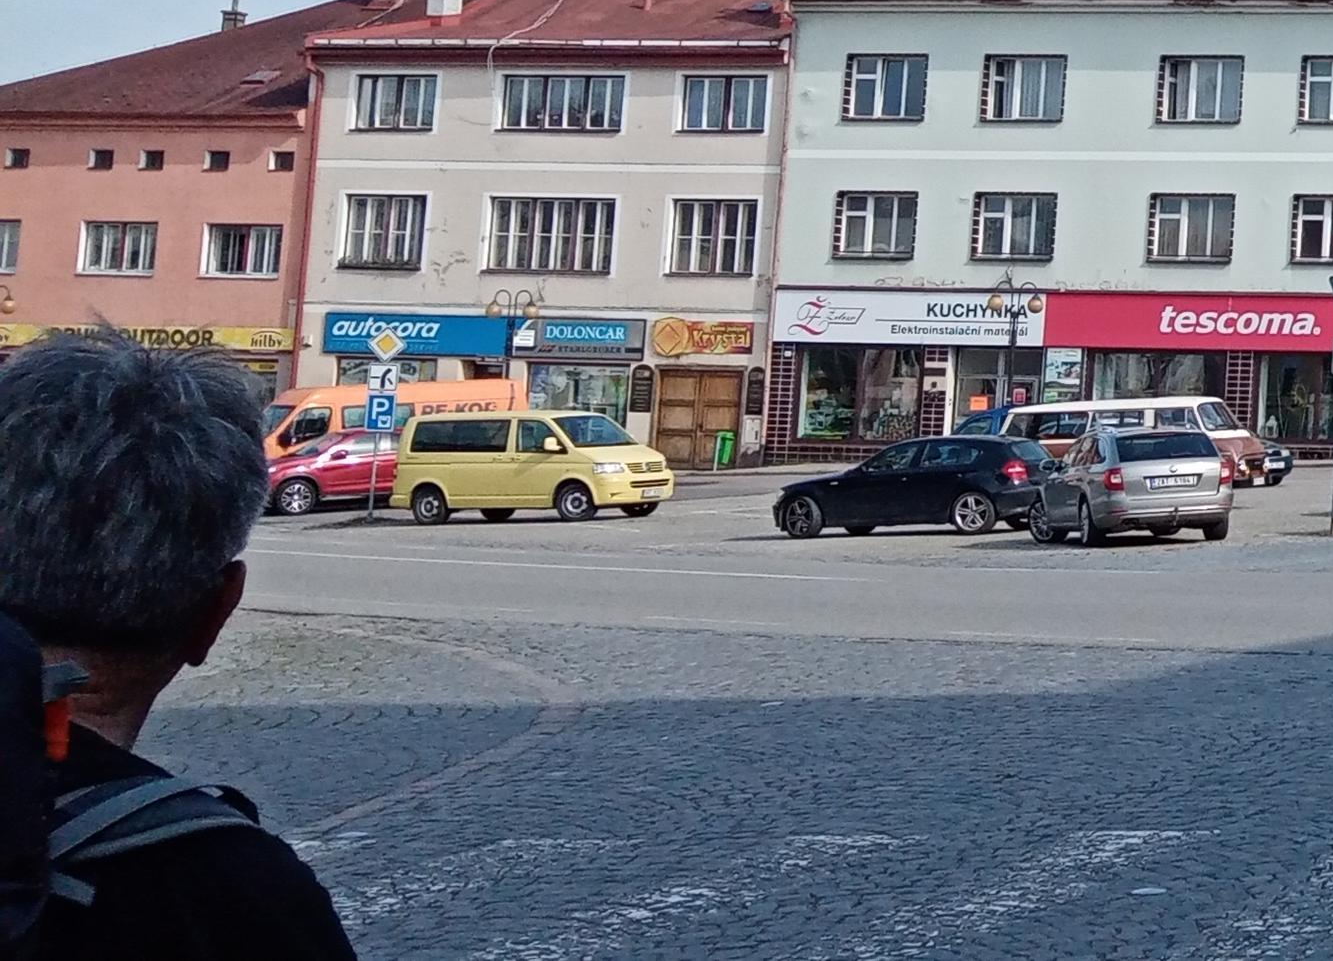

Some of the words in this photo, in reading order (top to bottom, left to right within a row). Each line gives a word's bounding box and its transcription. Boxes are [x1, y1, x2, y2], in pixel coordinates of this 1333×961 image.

[331, 316, 441, 339] autocora
[545, 324, 625, 341] DOLONCAR
[983, 324, 1029, 337] mateál
[692, 329, 752, 351] Krystal
[372, 398, 390, 420] P
